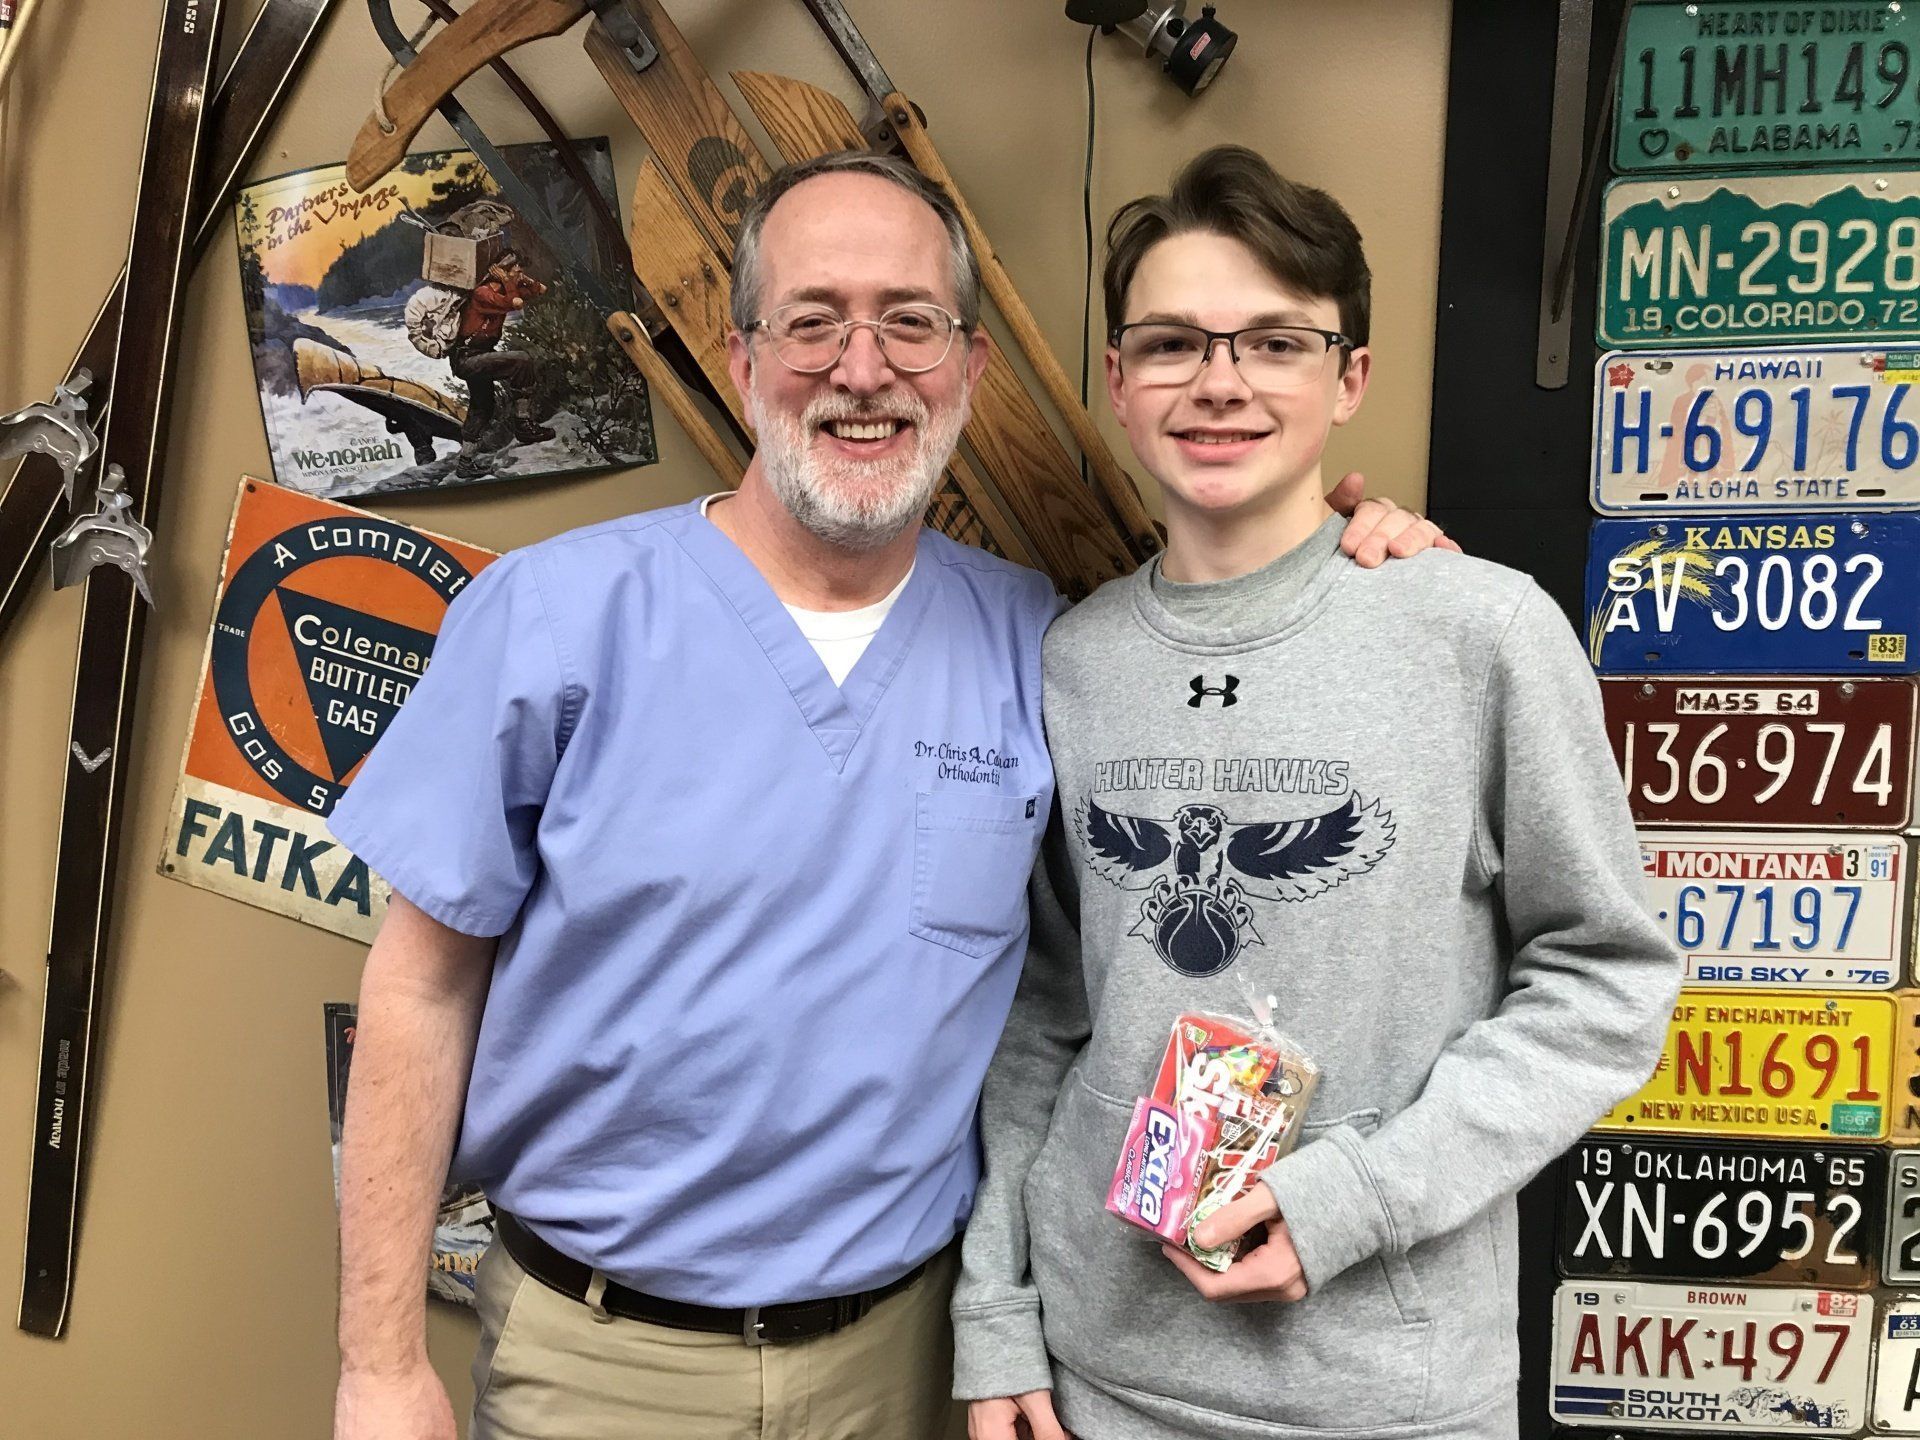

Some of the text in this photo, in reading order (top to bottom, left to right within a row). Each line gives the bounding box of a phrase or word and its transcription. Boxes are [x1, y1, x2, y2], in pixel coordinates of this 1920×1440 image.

[1698, 9, 1886, 36] HEART OF DIXIE
[1634, 40, 1920, 118] 11MH149
[1708, 123, 1861, 153] ALABAMA
[265, 182, 349, 234] Partners
[266, 184, 400, 250] in the Voyage
[1620, 216, 1920, 301] MN-2928
[1623, 299, 1918, 332] 19 COLORADO 72
[1715, 359, 1823, 381] HAWAII
[1611, 383, 1920, 474] H-69176
[1676, 478, 1850, 499] ALOHA STATE
[1684, 525, 1836, 550] KANSAS
[273, 543, 297, 569] A
[1711, 554, 1884, 632] 3082
[219, 623, 246, 637] TRADE
[1878, 636, 1897, 653] 83
[1679, 693, 1814, 711] MASS 64
[326, 700, 378, 736] GAS
[938, 742, 967, 761] Chris
[1094, 758, 1350, 796] HUNTER HAWKS
[1666, 849, 1888, 878] MONTANA 3 91
[1698, 966, 1890, 984] BIG SKY '76
[1672, 1006, 1852, 1027] OF ENCHANTMENT
[1677, 1029, 1879, 1101] N1691
[49, 1098, 65, 1149] norway
[1640, 1101, 1817, 1126] NEW MEXICO USA
[1123, 1149, 1135, 1183] CLASSIC
[1139, 1107, 1178, 1226] Extra
[1582, 1149, 1865, 1186] 19 OKLAHOMA 65
[1572, 1180, 1862, 1265] XN-6952
[1574, 1293, 1600, 1305] 19
[1687, 1291, 1748, 1306] BROWN
[1830, 1294, 1858, 1309] 82
[1900, 1319, 1918, 1330] 65
[1628, 1389, 1720, 1406] SOUTH
[1628, 1405, 1742, 1422] DAKOTA
